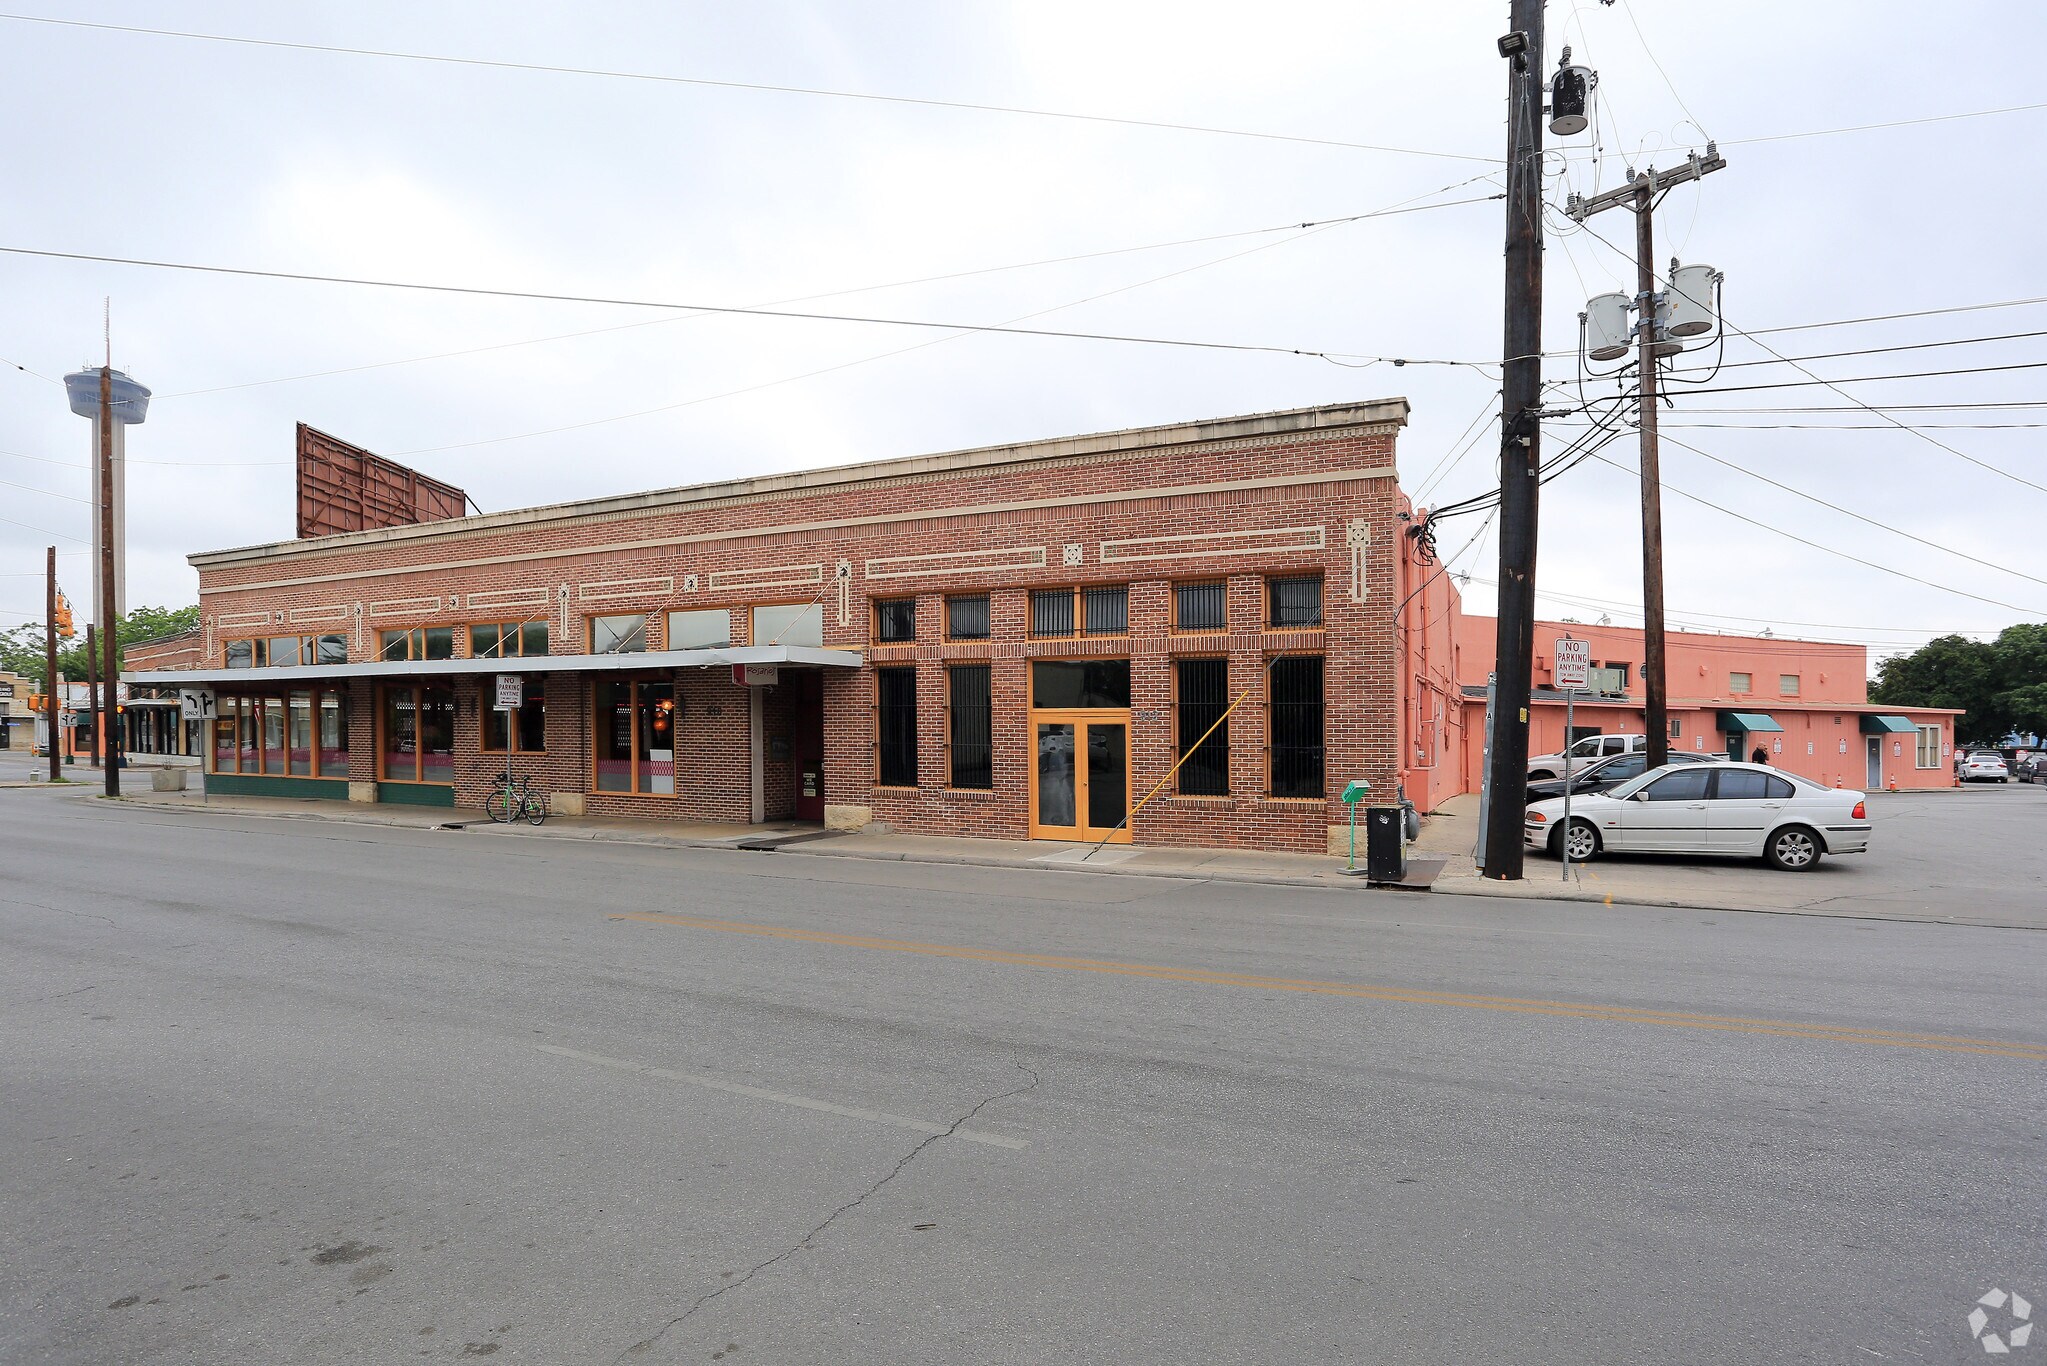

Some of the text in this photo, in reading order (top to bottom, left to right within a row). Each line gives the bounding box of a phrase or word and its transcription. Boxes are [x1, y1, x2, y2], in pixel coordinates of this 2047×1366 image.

[1565, 642, 1580, 651] NO
[1557, 652, 1587, 663] PARKING
[1558, 663, 1586, 671] ANYTIME
